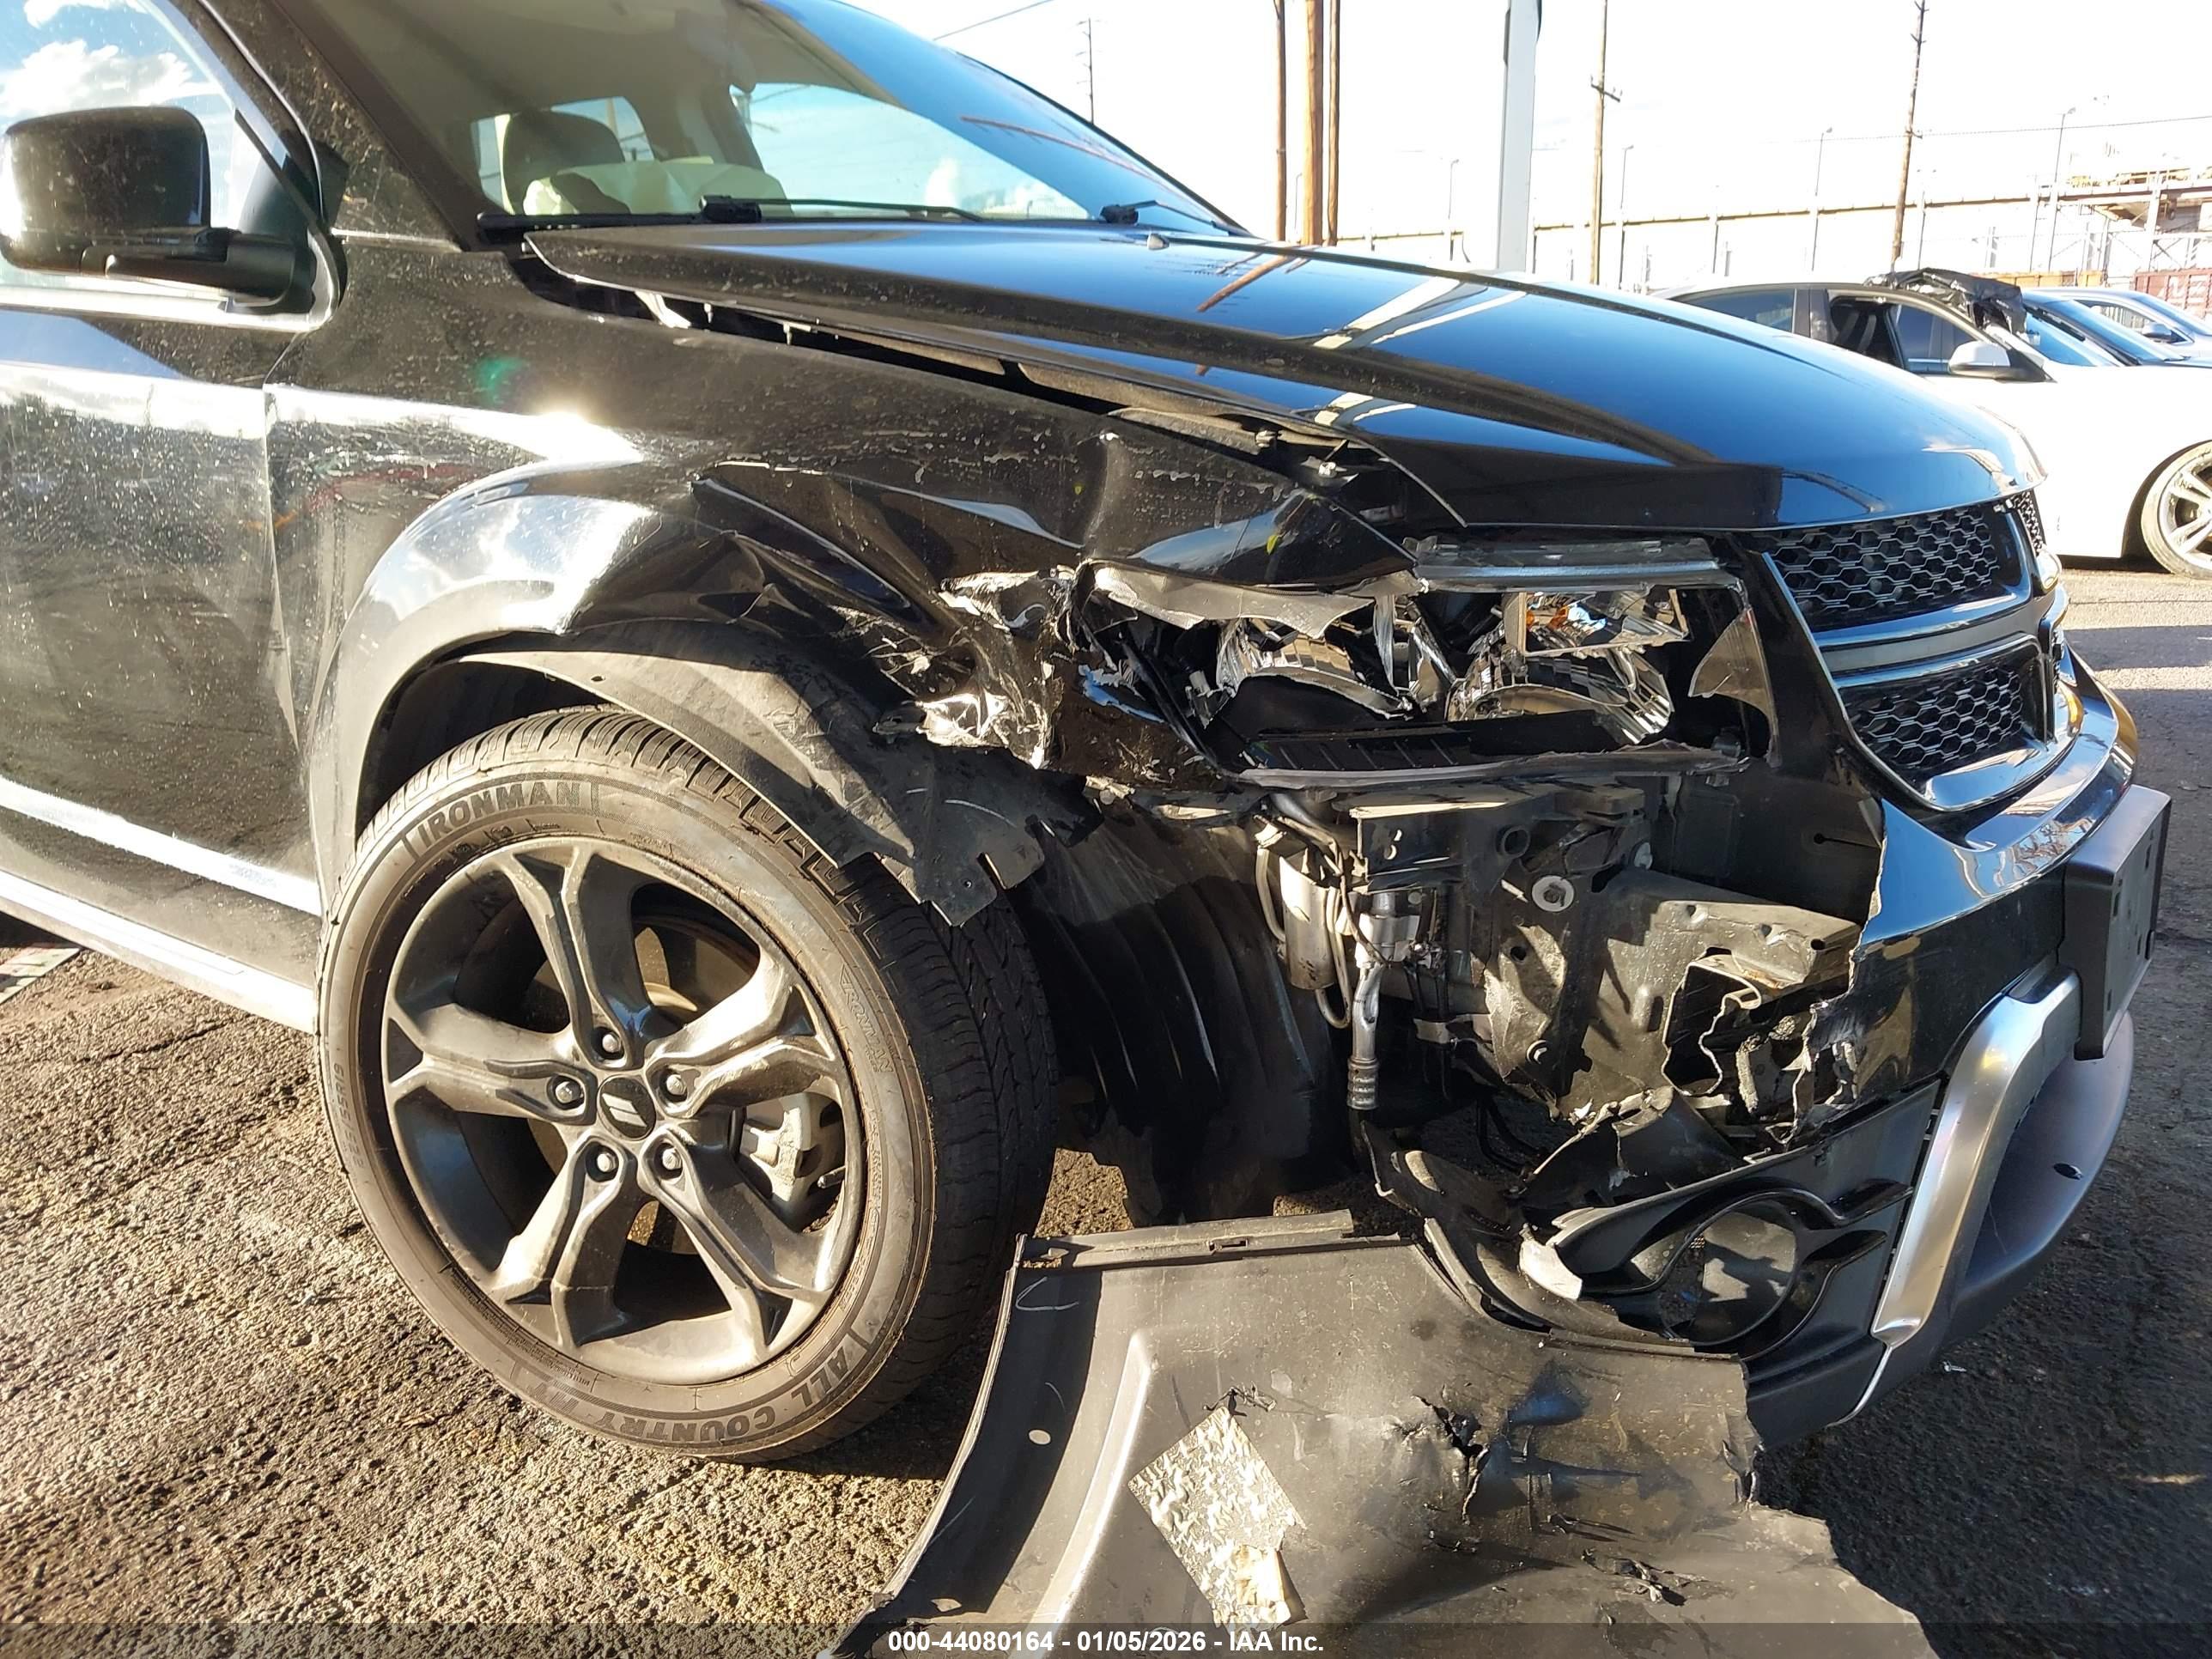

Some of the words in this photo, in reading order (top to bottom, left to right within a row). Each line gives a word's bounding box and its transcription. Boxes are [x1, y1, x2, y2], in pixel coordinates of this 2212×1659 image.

[417, 781, 582, 848] IRONMAN
[791, 1346, 849, 1407] ALL
[593, 1405, 776, 1443] COUNTRY
